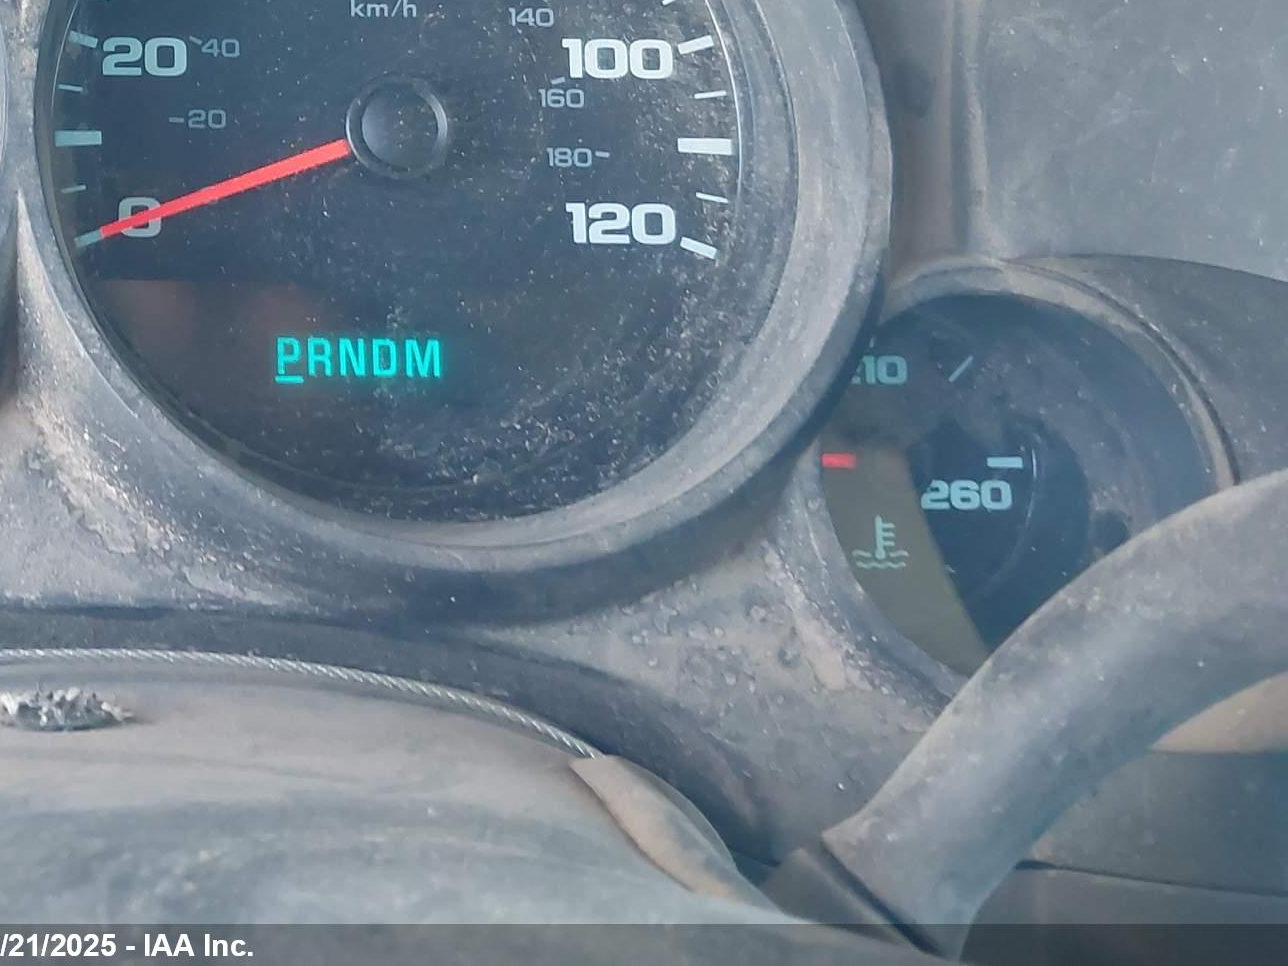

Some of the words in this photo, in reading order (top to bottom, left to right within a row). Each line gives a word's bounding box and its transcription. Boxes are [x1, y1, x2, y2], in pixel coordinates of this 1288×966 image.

[509, 7, 554, 27] 140
[102, 37, 188, 77] 20
[201, 38, 240, 58] 40
[562, 37, 673, 79] 100
[538, 88, 584, 108] 160
[187, 109, 227, 128] 20
[547, 148, 592, 167] 180
[117, 197, 162, 238] 0
[566, 202, 676, 245] 120
[276, 337, 441, 378] PRNDM
[851, 355, 908, 385] 10
[921, 480, 1012, 511] 260
